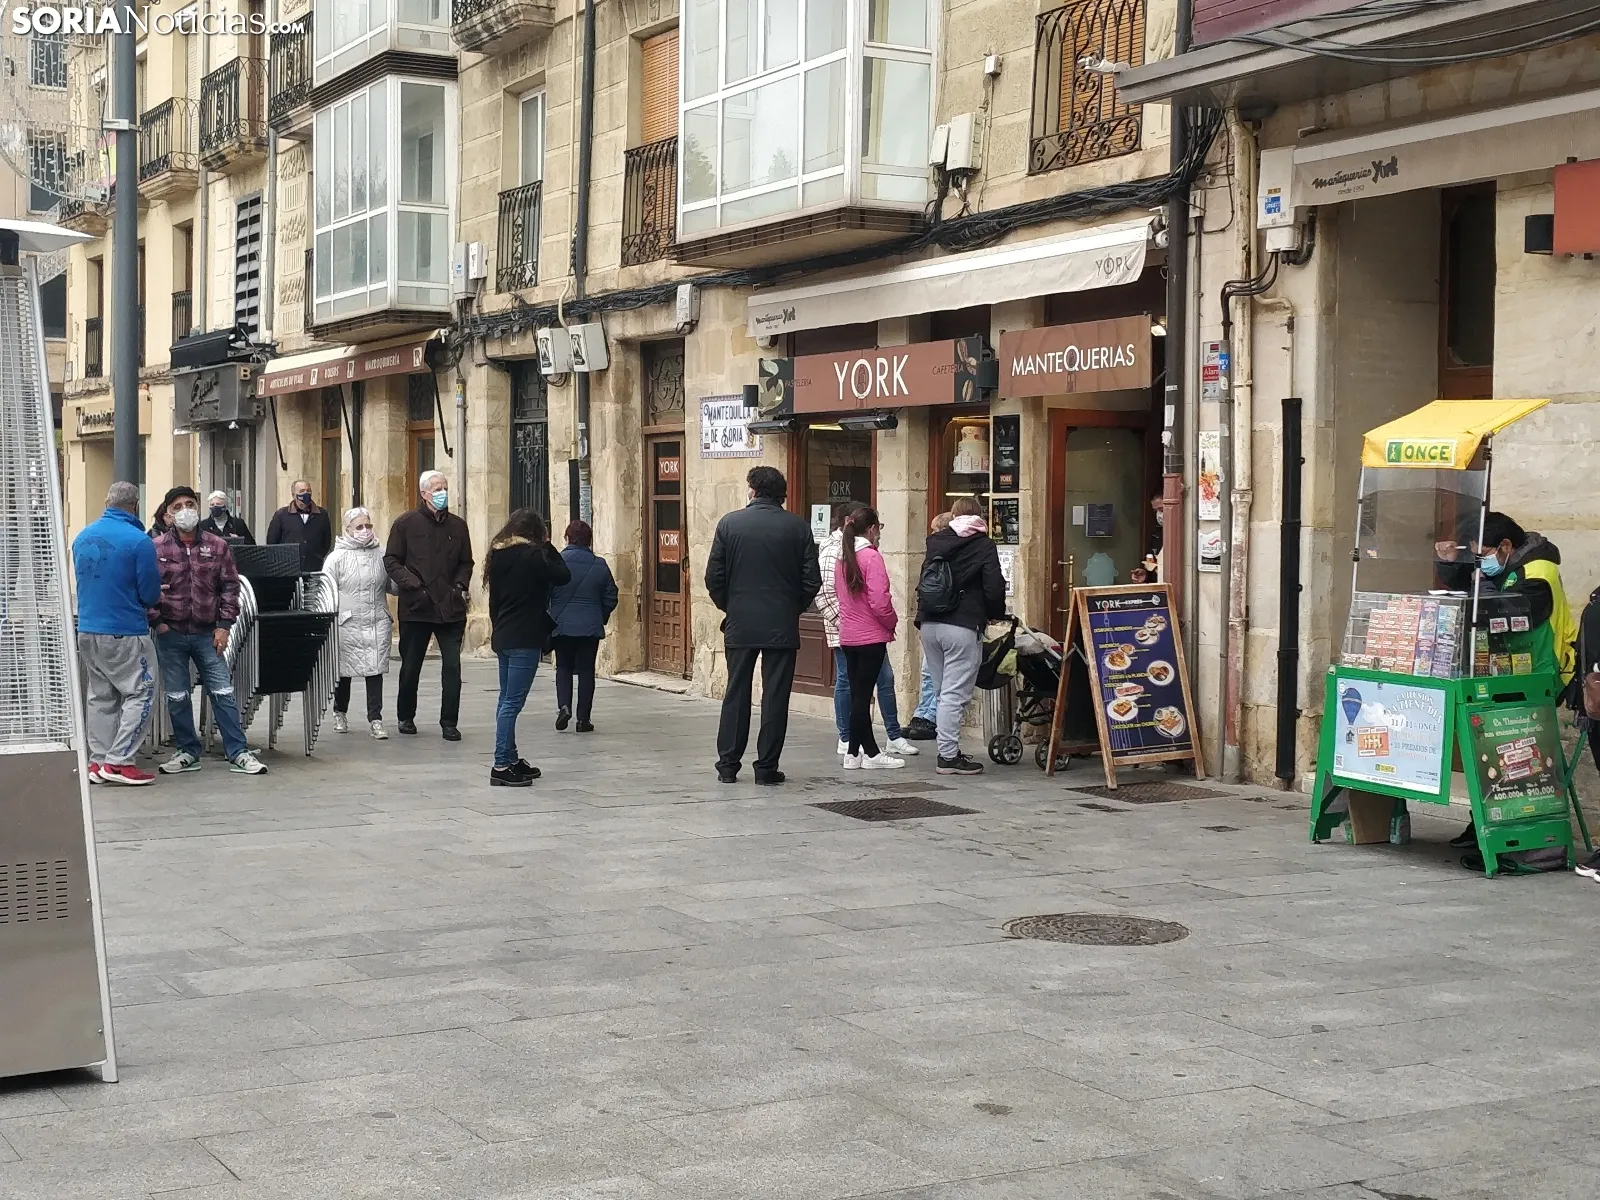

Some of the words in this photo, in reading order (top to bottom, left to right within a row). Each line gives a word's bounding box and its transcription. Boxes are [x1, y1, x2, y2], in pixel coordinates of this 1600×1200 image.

[1095, 255, 1132, 276] YORK
[1011, 343, 1135, 377] MANTEQUERIAS
[833, 354, 909, 400] YORK
[704, 403, 751, 425] MANTEQUILLA
[711, 429, 718, 443] DE
[721, 426, 743, 448] SORIA
[1404, 444, 1450, 461] ONCE
[660, 461, 679, 473] YORK
[660, 533, 679, 546] YORK
[1095, 599, 1121, 610] YORK
[1491, 784, 1501, 792] 75
